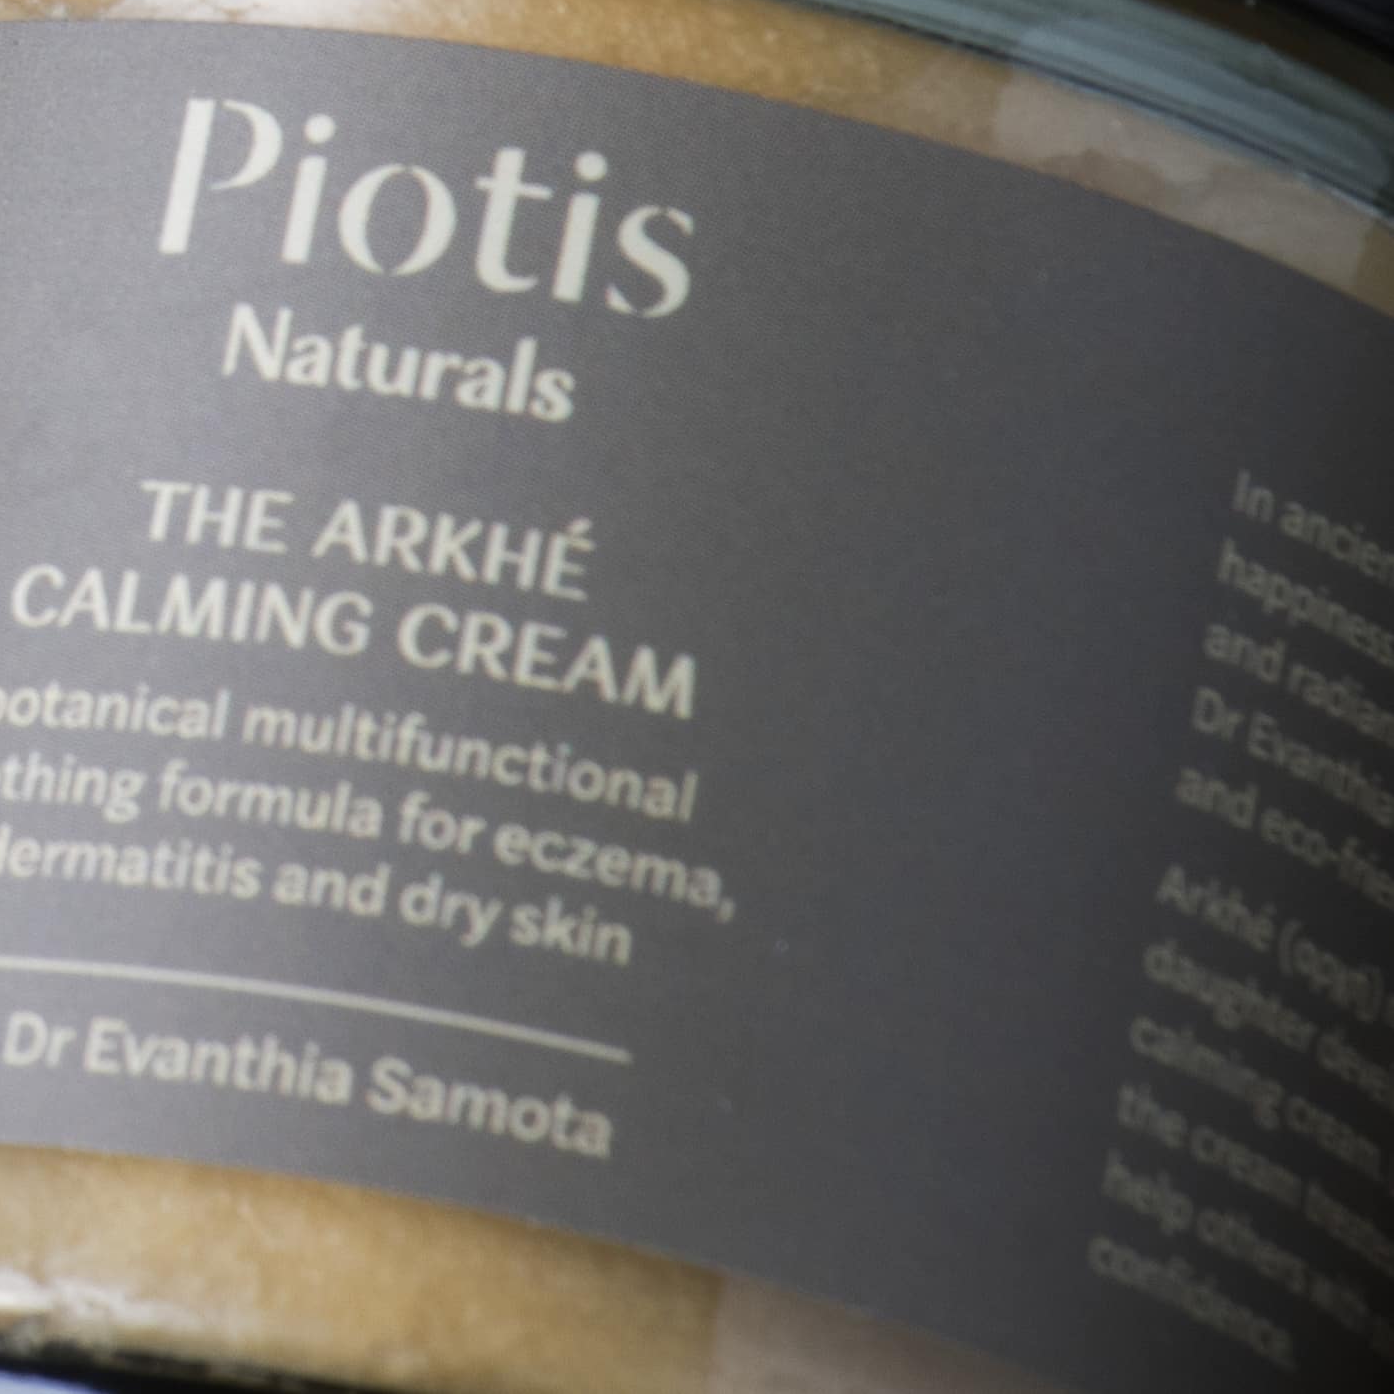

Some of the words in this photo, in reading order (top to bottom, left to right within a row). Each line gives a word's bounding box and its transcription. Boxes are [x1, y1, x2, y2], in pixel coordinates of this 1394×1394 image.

[157, 96, 696, 319] Piotis
[221, 301, 576, 423] Naturals
[140, 478, 294, 554] THE
[312, 498, 598, 603] ARKHÉ
[12, 563, 374, 659] CALMING
[396, 602, 697, 720] CREAM
[241, 695, 700, 825] multifunctional
[155, 758, 386, 840] formula
[397, 792, 486, 857] for
[493, 820, 738, 924] eczema,
[271, 856, 392, 918] and
[399, 871, 503, 949] dry
[508, 896, 634, 966] skin
[2, 1011, 75, 1068] Dr
[81, 1017, 356, 1107] Evanthia
[366, 1055, 615, 1161] Samota
